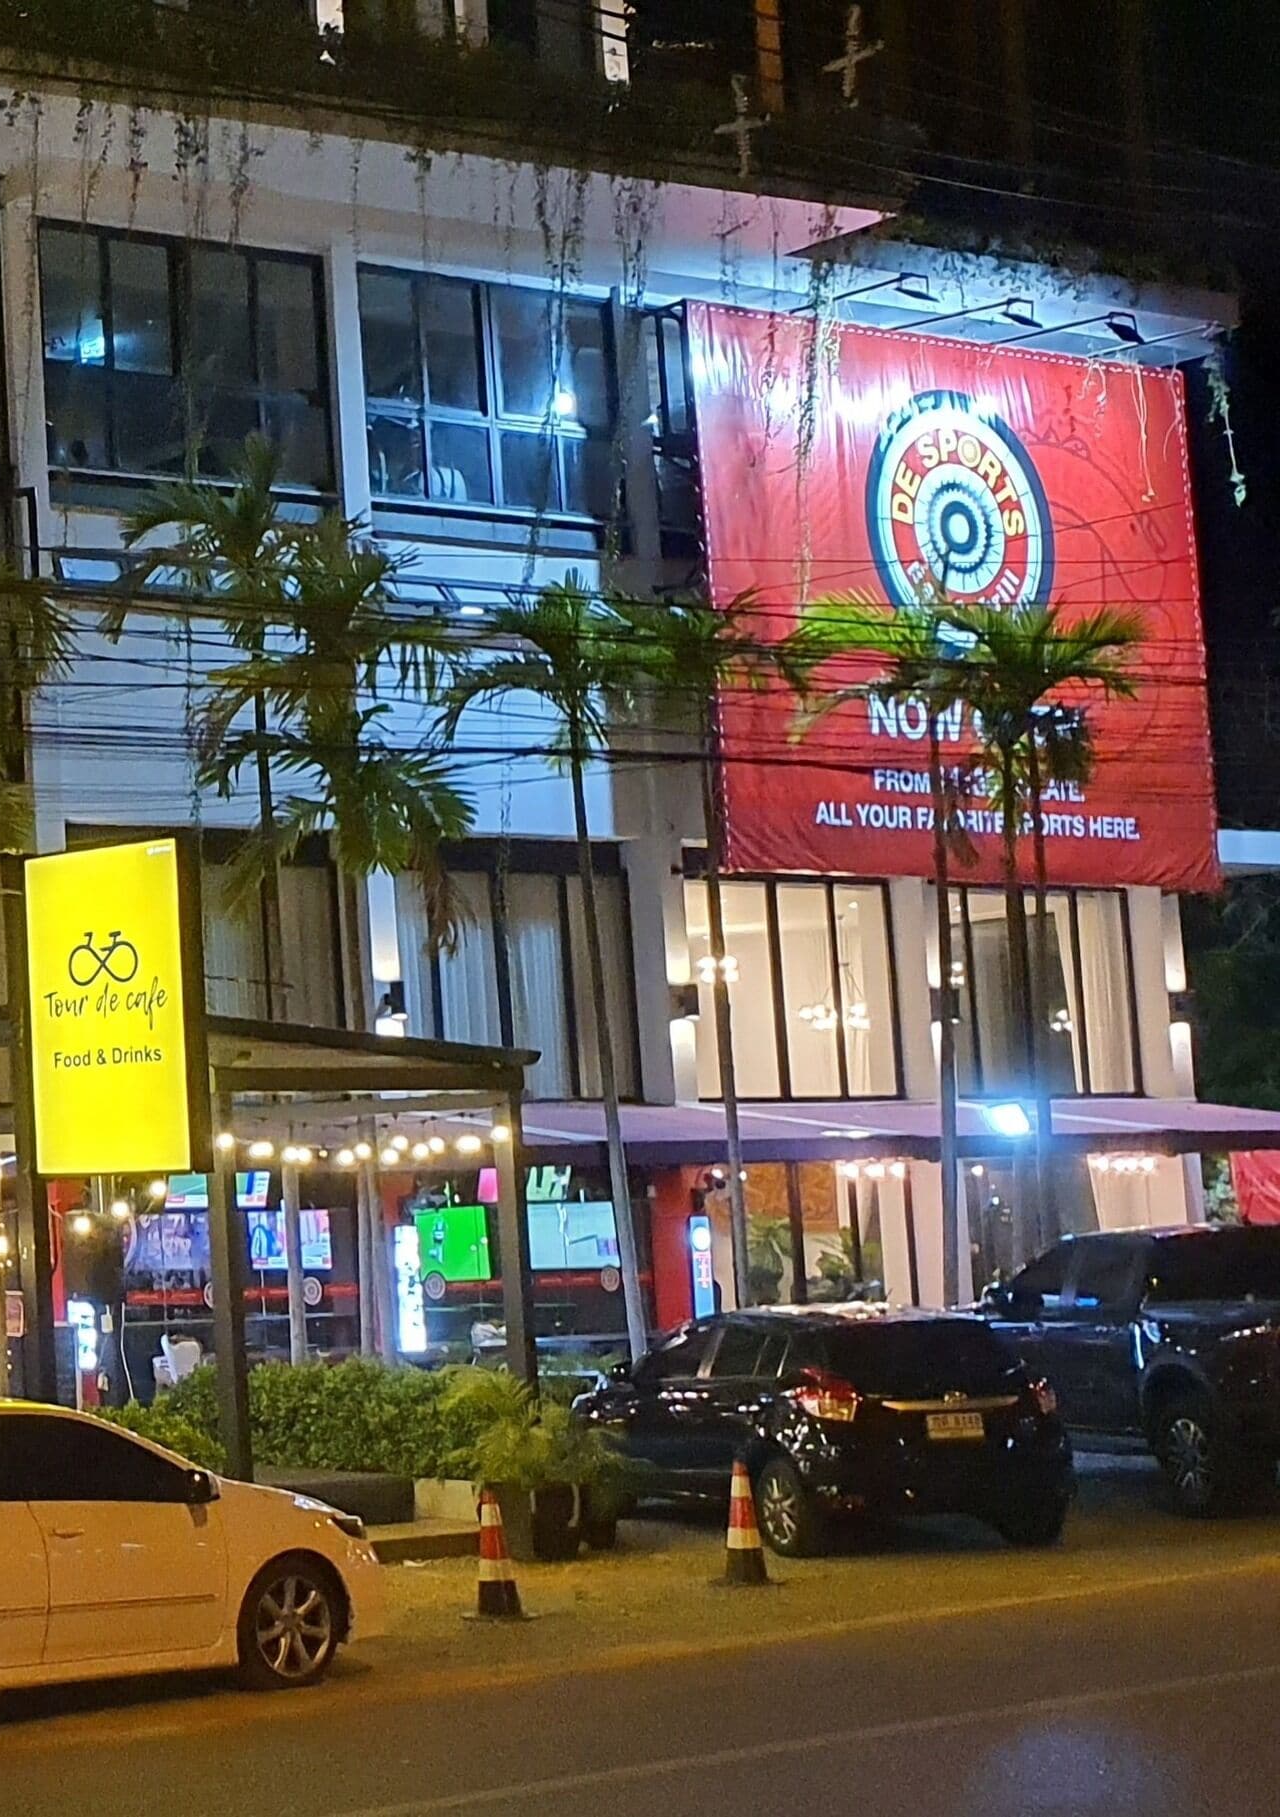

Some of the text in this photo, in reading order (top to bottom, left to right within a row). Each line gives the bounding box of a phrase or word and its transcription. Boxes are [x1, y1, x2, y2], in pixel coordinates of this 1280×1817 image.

[892, 427, 1025, 536] DE SPORTS
[873, 768, 932, 795] FROM
[815, 802, 1140, 840] ALL YOUR FARITE PORTS HERE.
[43, 975, 168, 1031] Tour de cafe
[53, 1045, 162, 1069] Food & Drinks
